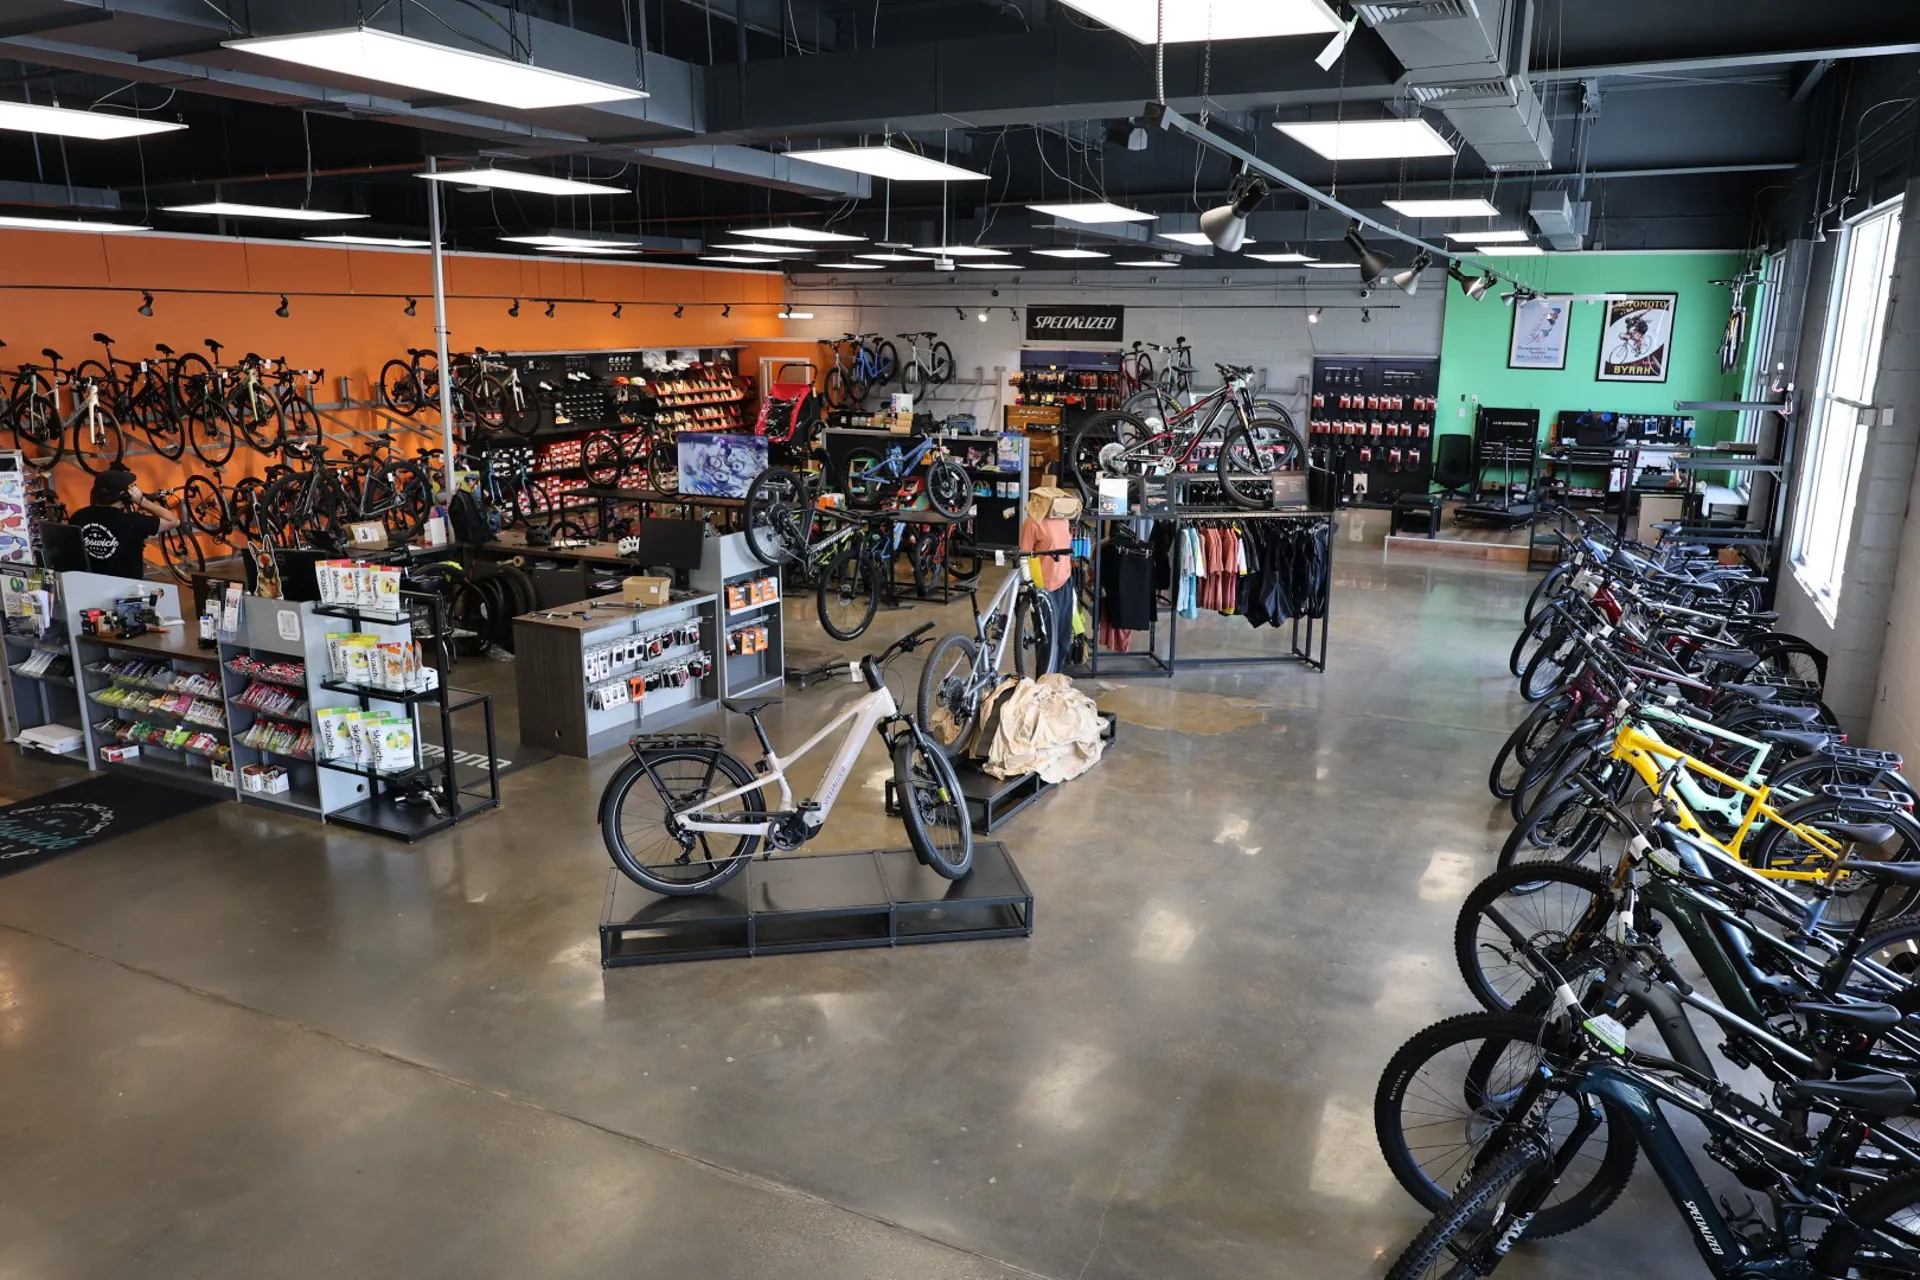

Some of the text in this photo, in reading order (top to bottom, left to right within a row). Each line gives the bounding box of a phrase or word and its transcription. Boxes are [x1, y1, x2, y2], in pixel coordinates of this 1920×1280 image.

[1033, 315, 1118, 330] SPECIALIZED
[1496, 1213, 1532, 1255] FOX
[1682, 1199, 1725, 1256] SPECIALIZED
